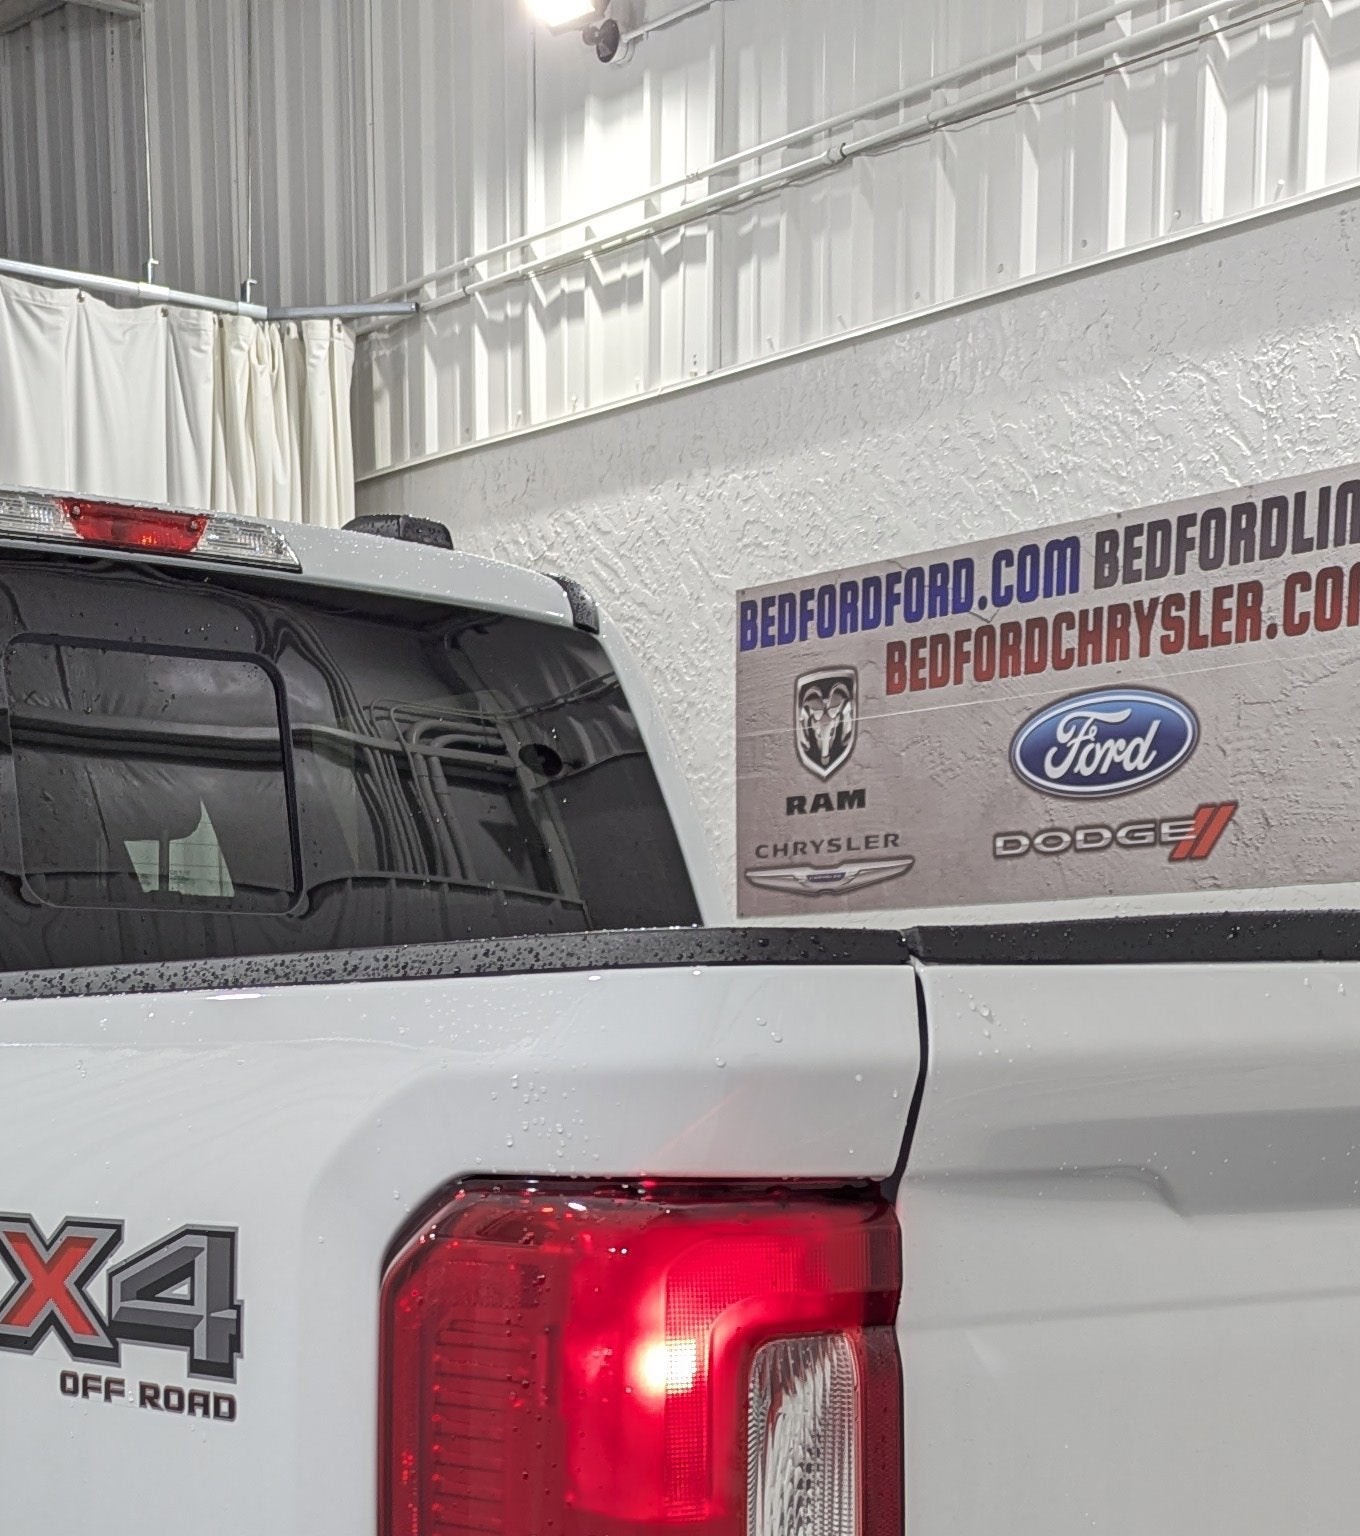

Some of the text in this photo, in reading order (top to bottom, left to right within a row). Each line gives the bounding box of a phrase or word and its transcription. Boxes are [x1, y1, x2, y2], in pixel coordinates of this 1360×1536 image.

[739, 535, 1081, 652] BEDFORDFORD.COM
[1043, 706, 1162, 780] Ford
[785, 788, 867, 816] RAM
[754, 832, 901, 859] CHRYSLER
[993, 818, 1199, 859] DODGE
[60, 1369, 237, 1422] OFF ROAD
